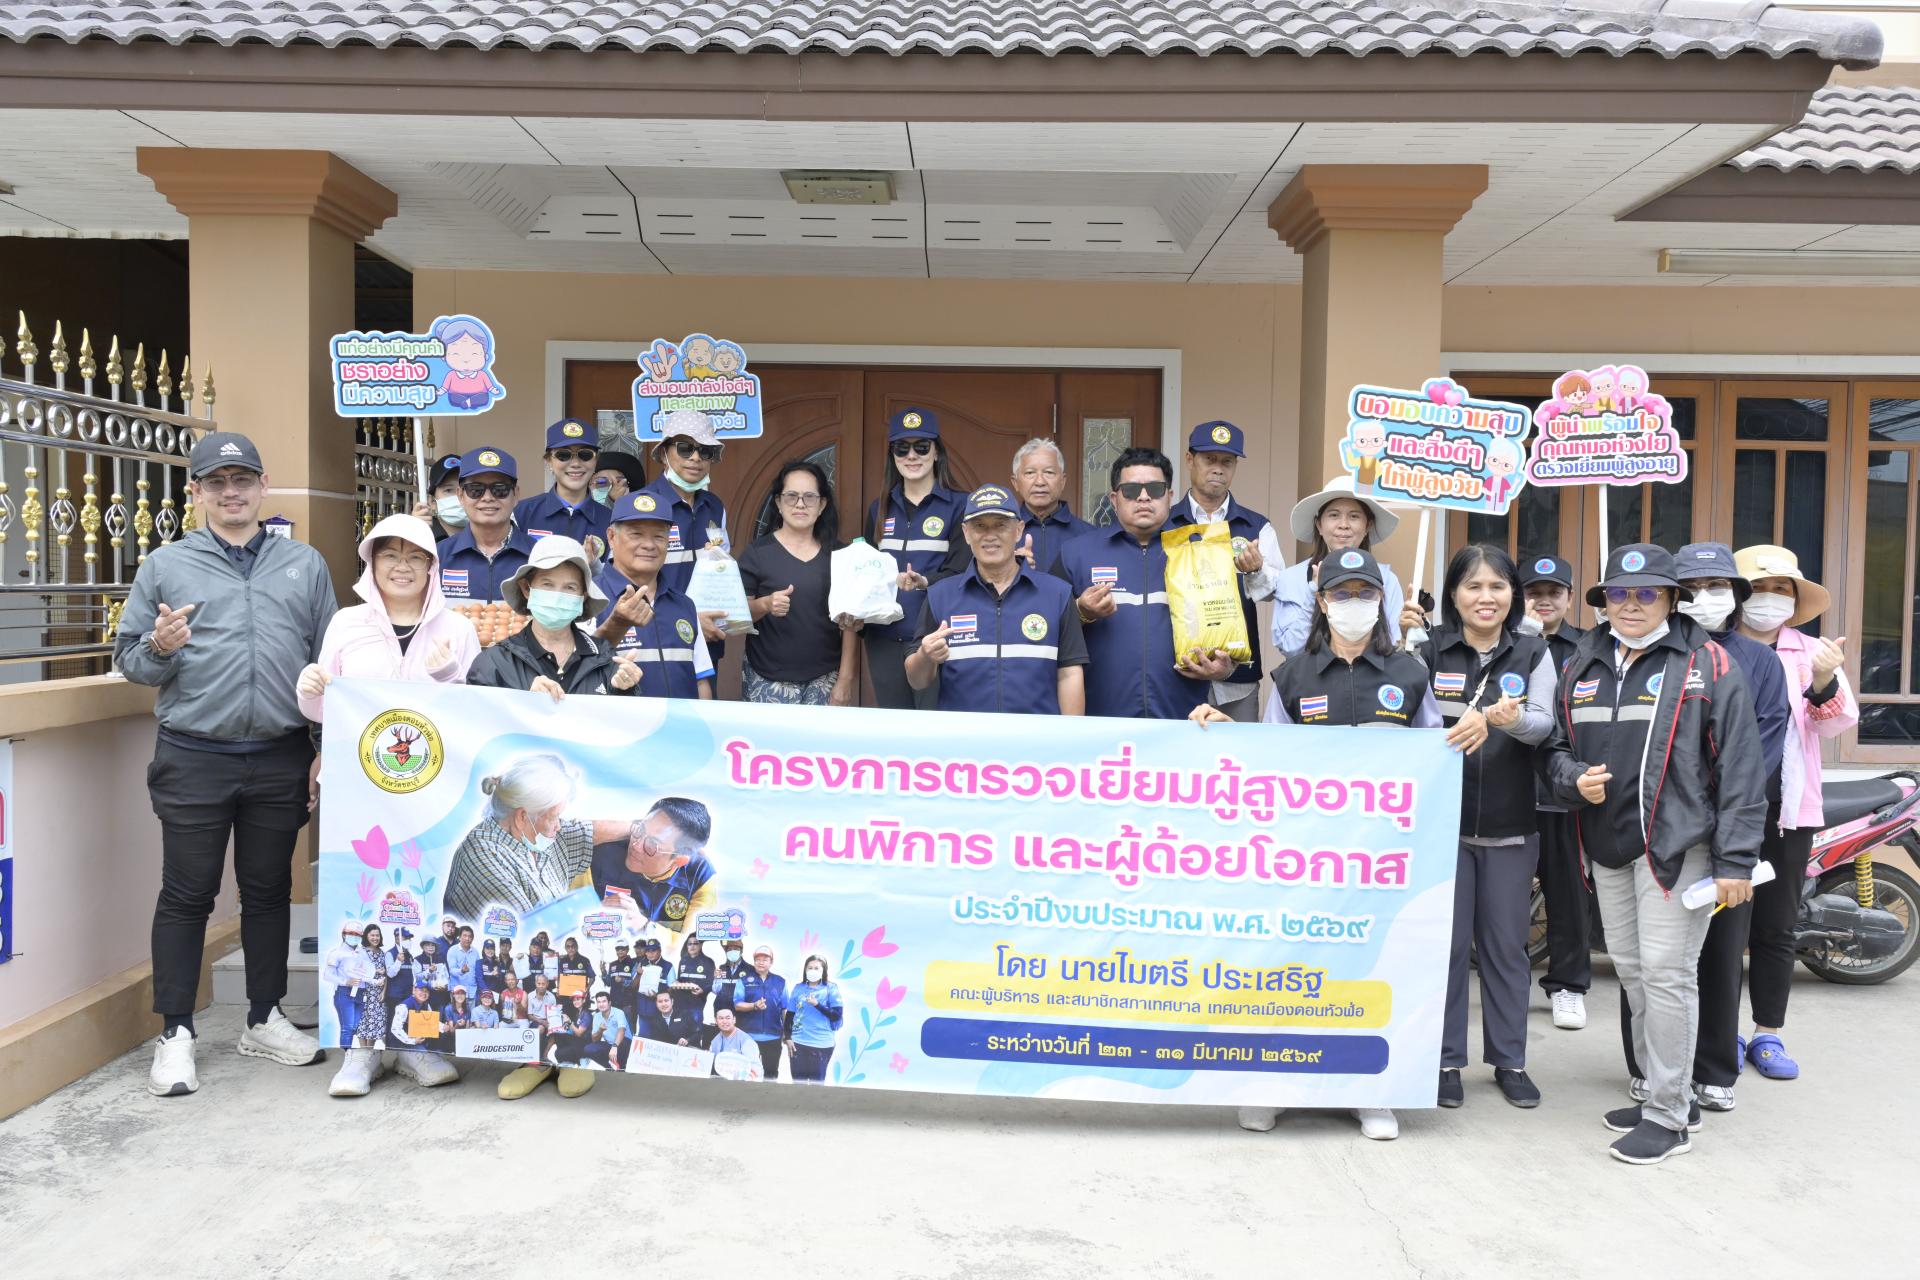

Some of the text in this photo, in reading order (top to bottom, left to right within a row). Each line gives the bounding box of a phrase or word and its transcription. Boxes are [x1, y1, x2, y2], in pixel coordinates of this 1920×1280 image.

[339, 339, 444, 358] แก่อย่างมีคุณค่า
[342, 360, 427, 380] ชราอย่าง
[343, 384, 436, 407] มีความสุข
[639, 377, 754, 396] ส่งมอบกำลังใจดีๆ
[661, 396, 735, 411] และสุขภาพ
[1359, 396, 1519, 435] ขอมอบความสุข
[1551, 411, 1659, 438] ผู้นำพร้อมใจ
[1389, 432, 1481, 468] และสิ่งดีๆ
[1543, 434, 1668, 460] คุณหมอห่วงใย
[1383, 462, 1481, 496] ให้ผู้สูงวัย
[1536, 456, 1677, 476] ตรวจเยี่ยมผู้สูงอายุ
[381, 776, 420, 789] จังหวัดชลบุรี
[726, 740, 1414, 828] โครงการตรวจเยี่ยมผู้สูงอายุ
[786, 818, 1409, 887] คนพิการ และผู้ด้อยโอกาส
[955, 895, 1370, 940] ประจำปีงบประมาณ พ.ศ. ๒๕๖๙
[997, 944, 1323, 999] โดย นายไมตรี ประเสริฐ
[950, 986, 1365, 1018] คณะผู้บริหาร และสมาชิกสภาเทศบาล เทศบาลเมืองดอนหัวฬ่อ
[473, 1045, 524, 1053] BRIDGESTONE
[987, 1033, 1090, 1055] ระหว่างวันที่
[1098, 1043, 1132, 1057] ๒๓
[1156, 1048, 1184, 1060] ๓๑
[1193, 1043, 1253, 1062] มีนาคม
[1261, 1048, 1322, 1063] ๒๕๖๙
